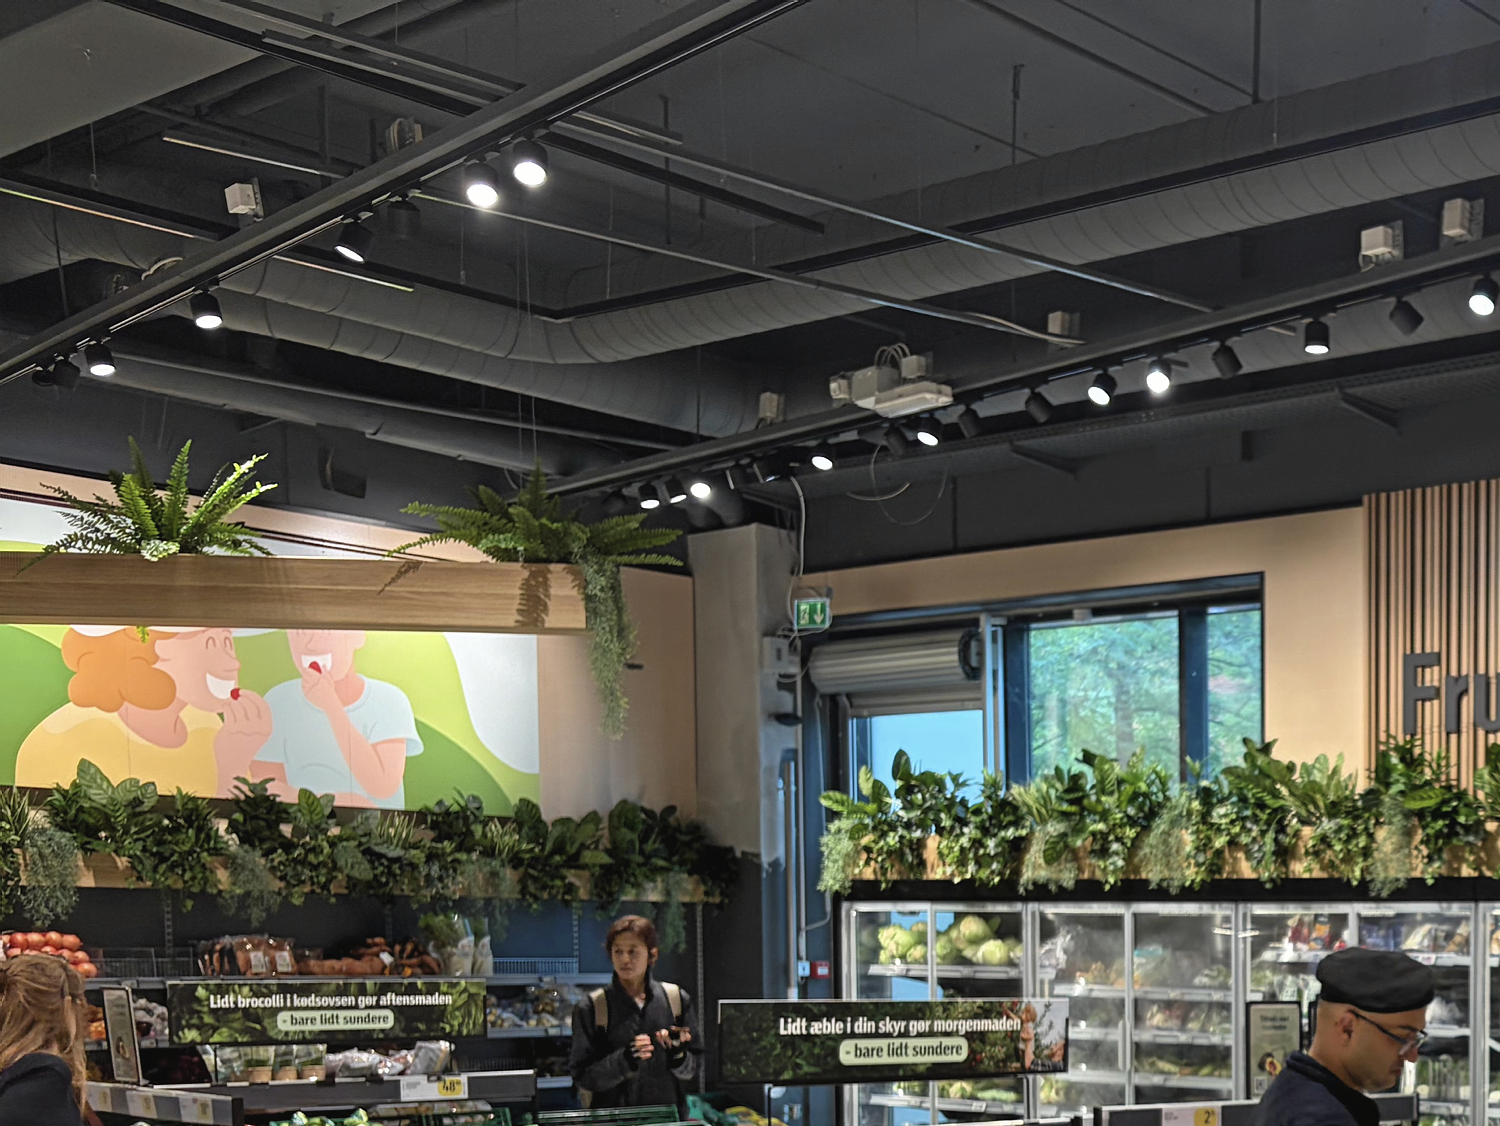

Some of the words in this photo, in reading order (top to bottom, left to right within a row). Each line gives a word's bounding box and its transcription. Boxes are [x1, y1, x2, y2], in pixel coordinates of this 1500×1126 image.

[209, 994, 235, 1009] Lidt
[237, 993, 284, 1008] brocolli
[293, 993, 356, 1008] kødsovsen
[358, 996, 378, 1009] gør
[380, 992, 453, 1007] aftensmaden
[290, 1011, 317, 1026] bare
[320, 1011, 340, 1026] lidt
[343, 1010, 389, 1025] sundere
[779, 1017, 807, 1036] Lidt
[810, 1017, 844, 1035] æble
[846, 1017, 852, 1033] i
[854, 1017, 876, 1034] din
[878, 1018, 907, 1036] skyr
[909, 1019, 931, 1036] gør
[933, 1017, 1021, 1034] morgenmaden
[854, 1041, 884, 1059] bare
[887, 1041, 910, 1058] lidt
[912, 1040, 963, 1057] sundere
